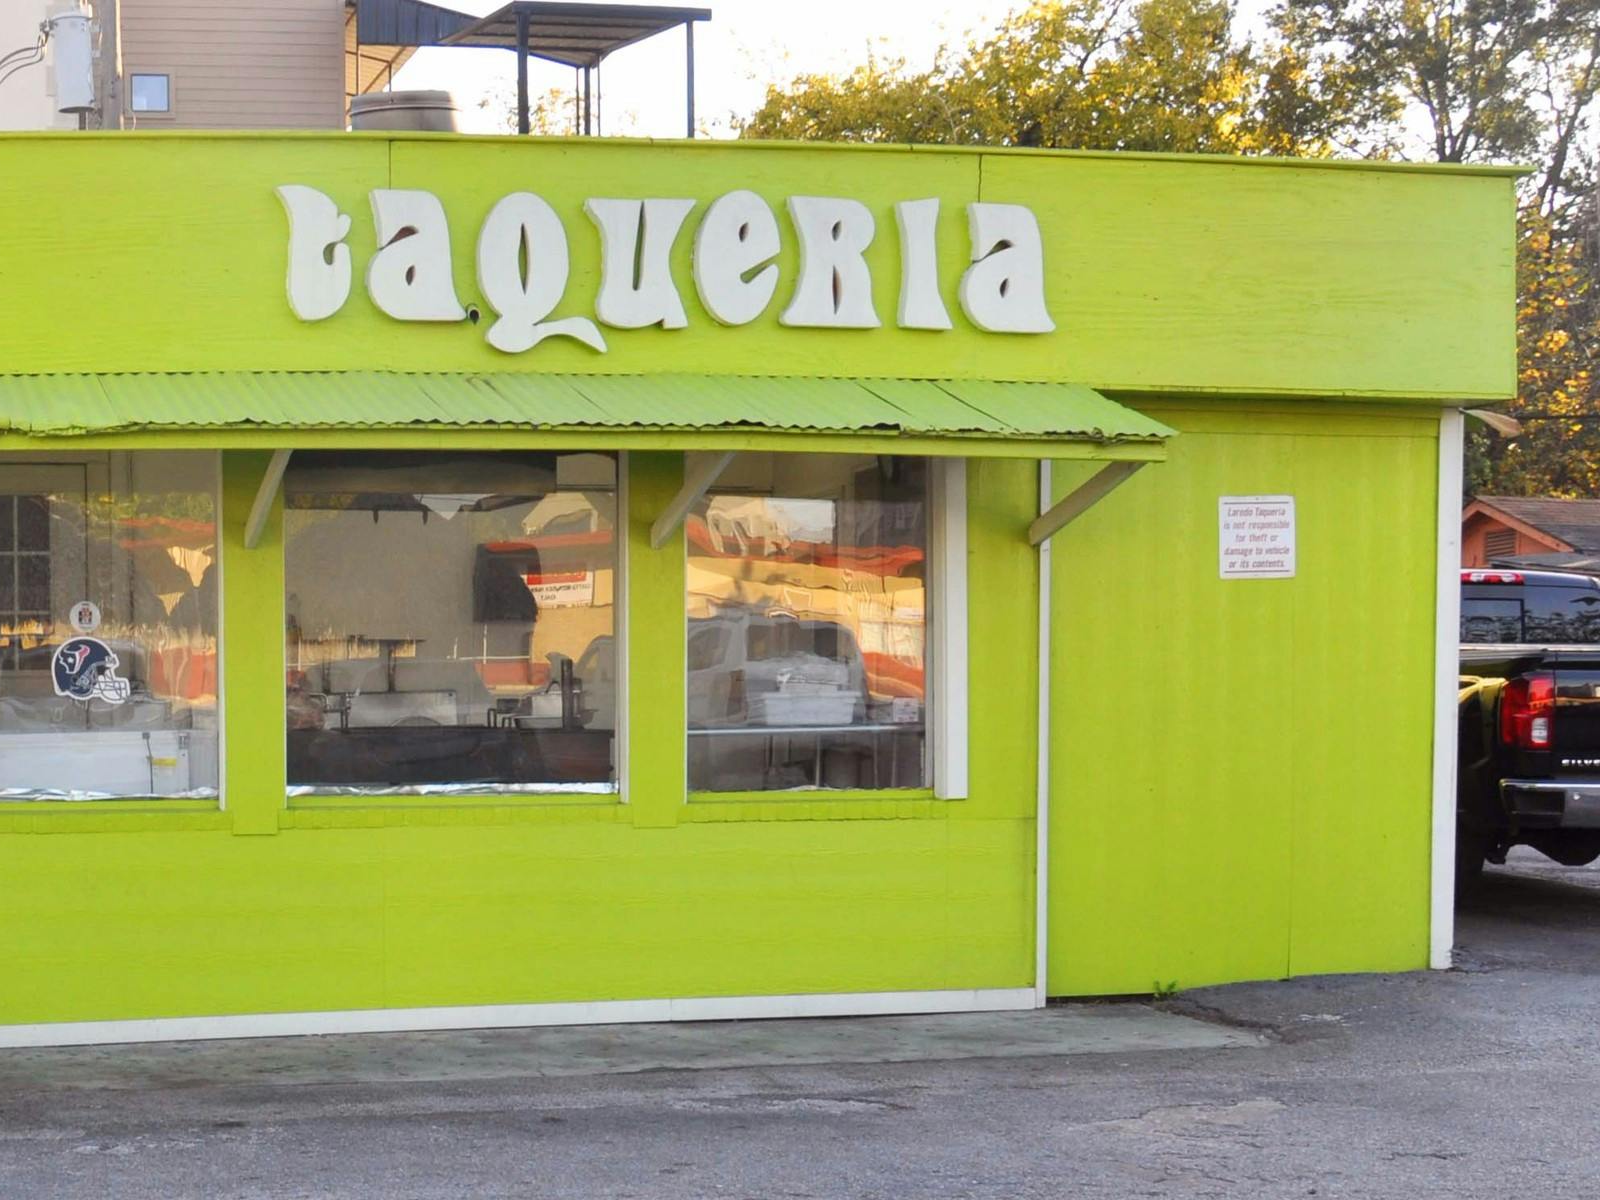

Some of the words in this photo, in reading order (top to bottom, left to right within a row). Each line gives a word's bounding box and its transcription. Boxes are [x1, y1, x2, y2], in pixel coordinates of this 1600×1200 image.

[1227, 507, 1254, 517] Laredo
[1255, 507, 1286, 518] Taqueria
[1223, 521, 1231, 530] is
[1232, 521, 1247, 530] not
[1248, 520, 1290, 530] responsible
[1235, 534, 1247, 543] for
[1248, 533, 1268, 543] theft
[1223, 546, 1254, 557] damage
[1255, 547, 1264, 555] to
[1265, 546, 1290, 555] vehicle
[1240, 560, 1250, 568] its
